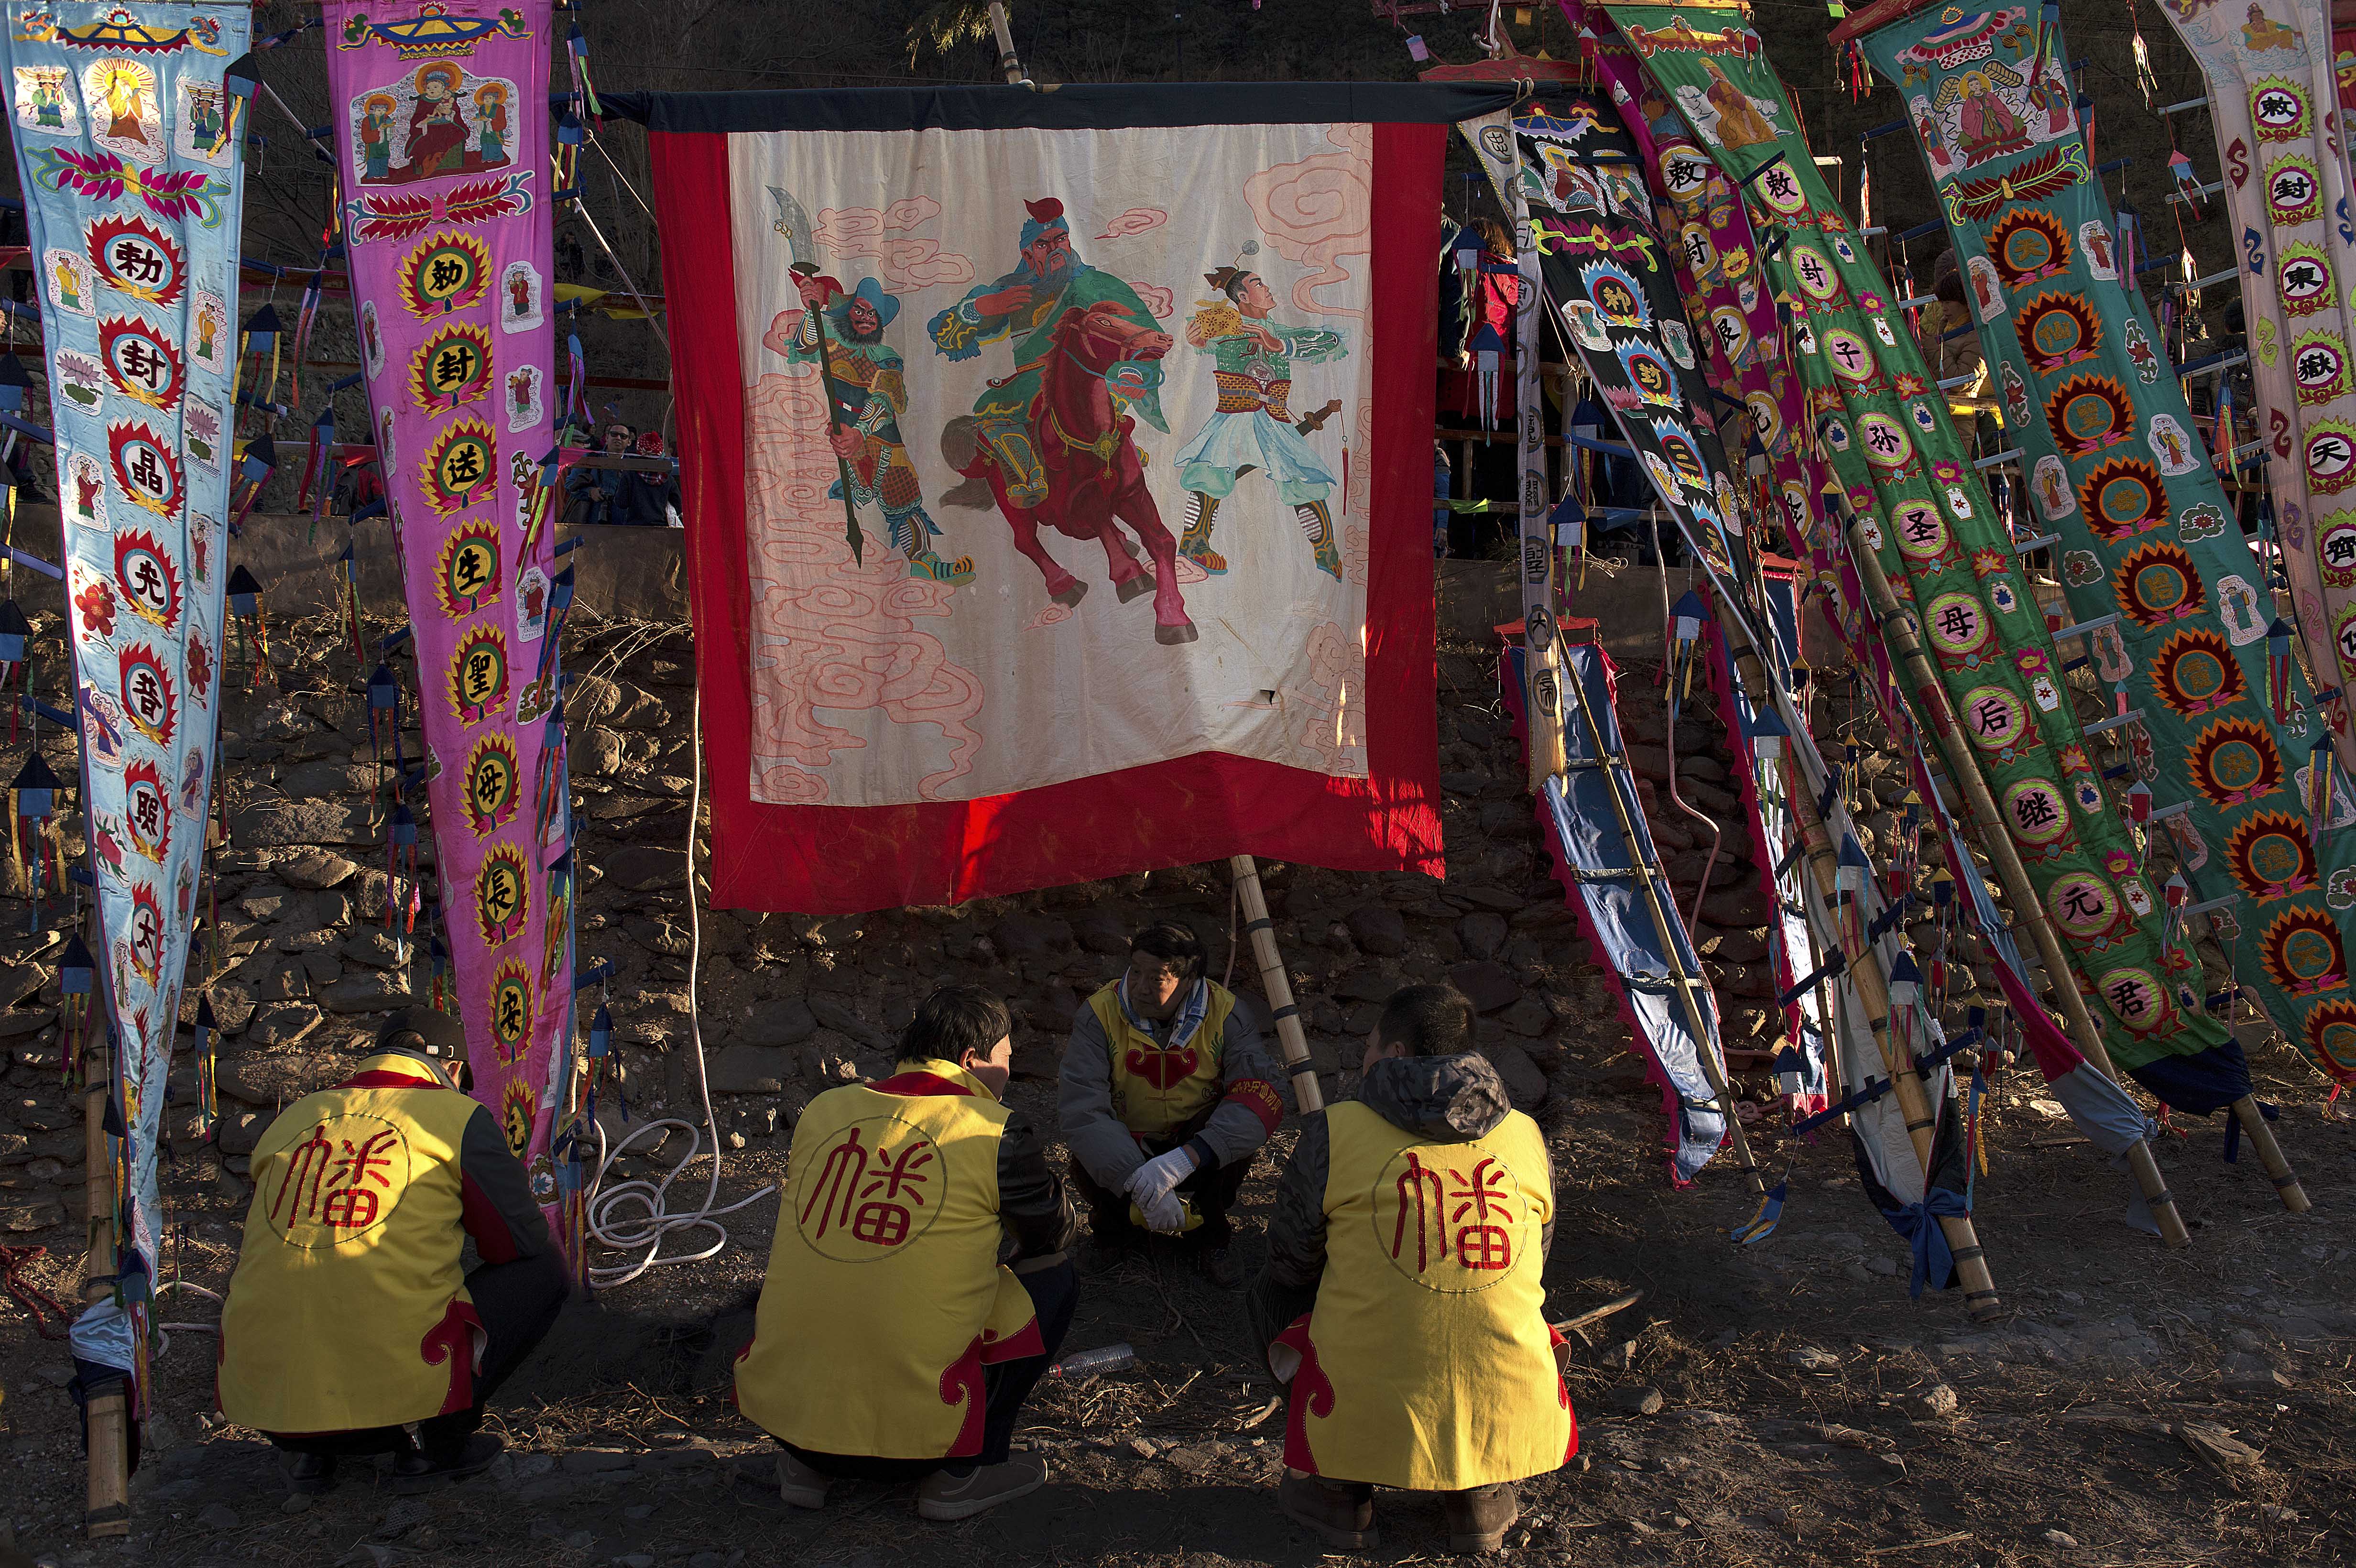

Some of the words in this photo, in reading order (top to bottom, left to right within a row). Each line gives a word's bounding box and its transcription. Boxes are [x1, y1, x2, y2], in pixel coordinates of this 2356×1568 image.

[1766, 170, 2145, 1018] 敕封子孙圣母后继元君
